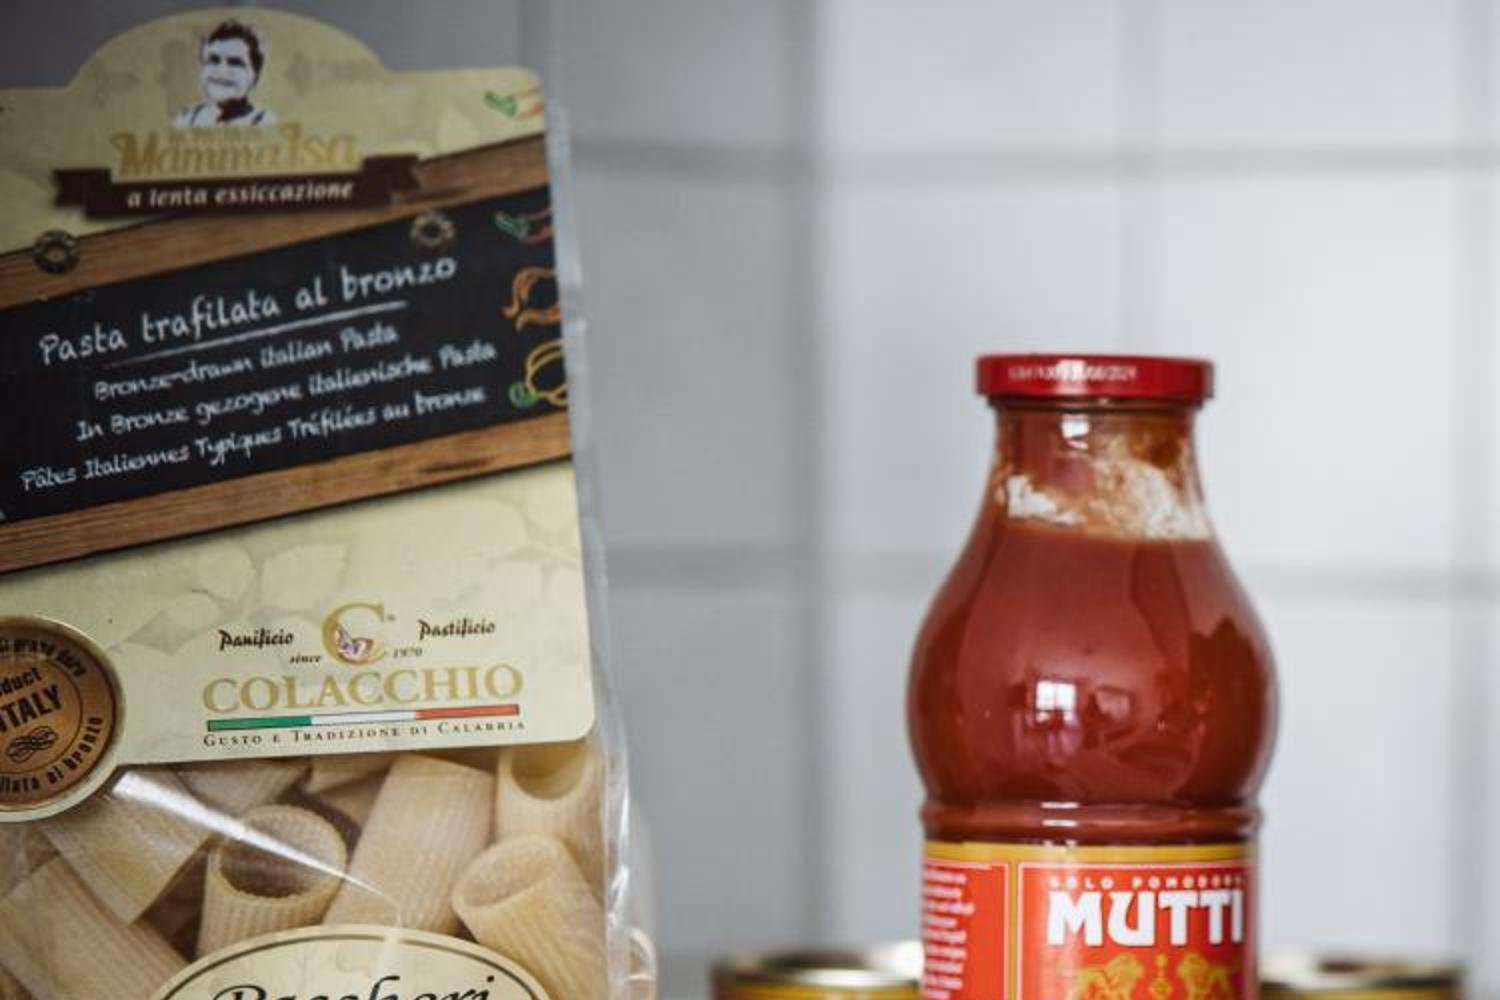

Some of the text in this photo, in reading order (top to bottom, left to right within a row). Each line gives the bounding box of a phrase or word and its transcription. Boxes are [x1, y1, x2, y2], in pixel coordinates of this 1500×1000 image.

[126, 179, 354, 209] a lenta essiccazione
[39, 256, 458, 366] Pasta trafilata al bronzo
[339, 321, 399, 353] Pasta
[76, 339, 498, 442] In Bronze gezogene italienische Pasta
[83, 445, 190, 480] Italiennes
[194, 425, 283, 467] Typiques
[288, 404, 378, 440] Tréfilées
[382, 402, 411, 423] au
[414, 385, 487, 415] bronze
[216, 627, 296, 652] Panificio
[416, 616, 497, 641] Pastificio
[288, 652, 323, 666] since
[0, 666, 42, 699] duct
[201, 662, 525, 714] COLACCHIO
[1049, 875, 1115, 890] SOLO
[1046, 888, 1244, 947] MUTTI
